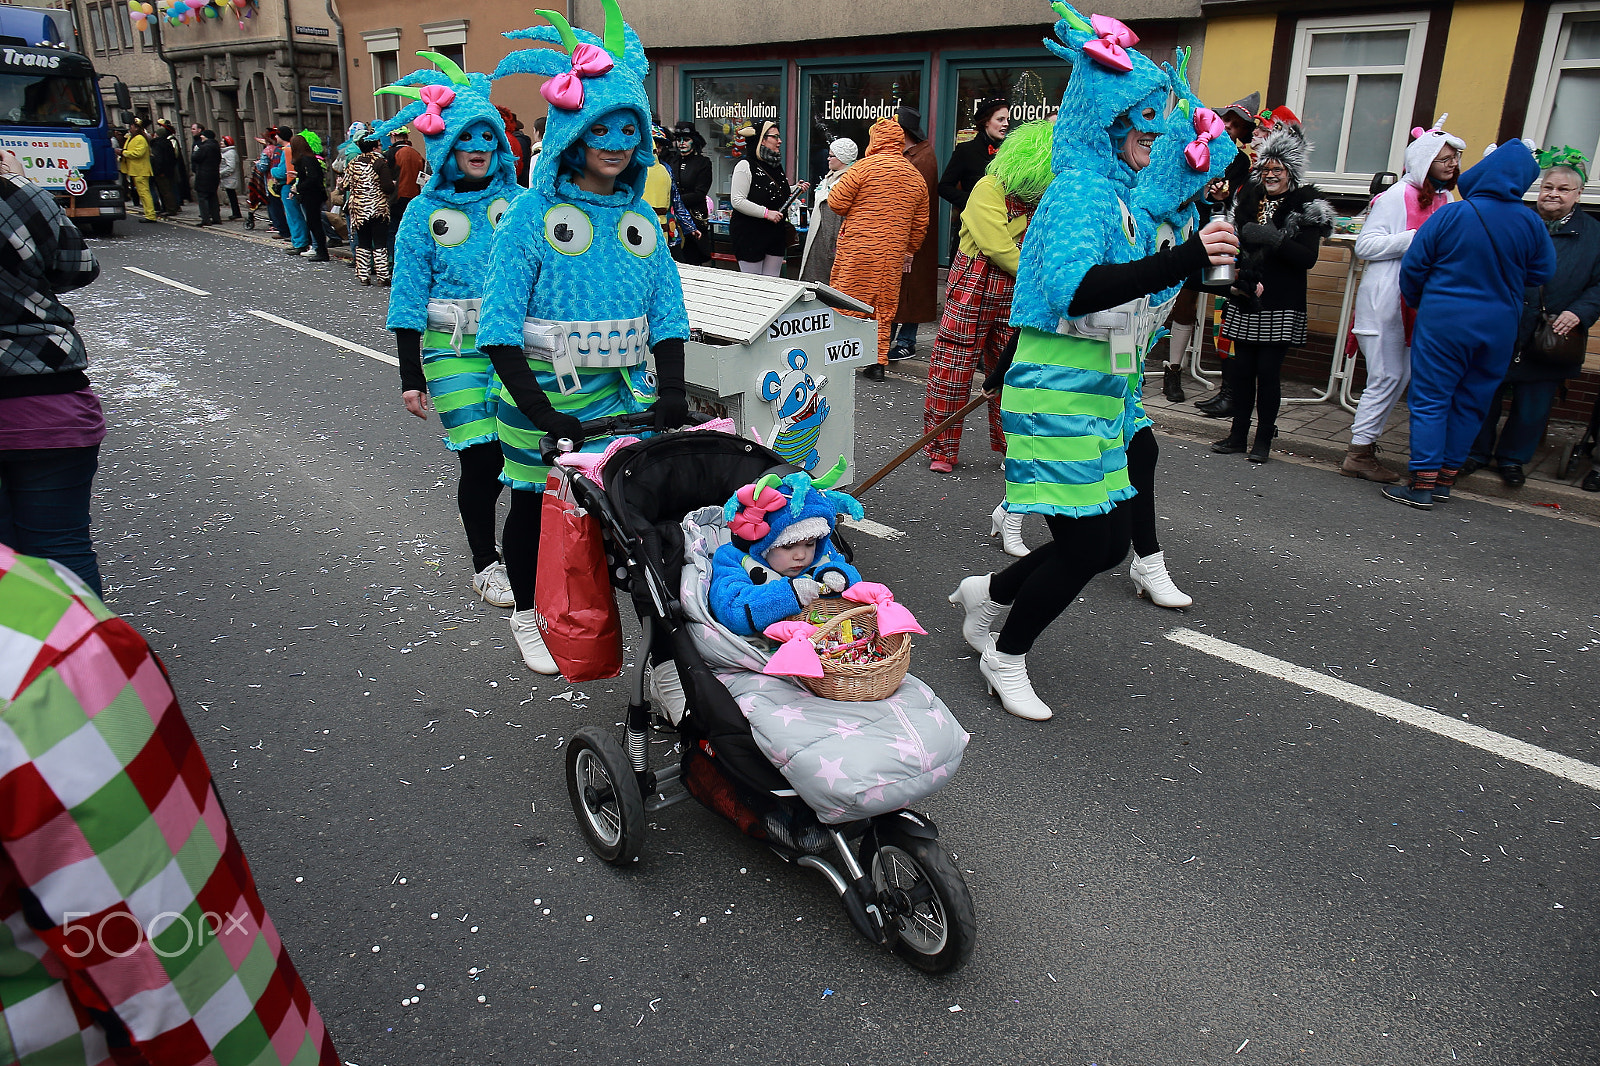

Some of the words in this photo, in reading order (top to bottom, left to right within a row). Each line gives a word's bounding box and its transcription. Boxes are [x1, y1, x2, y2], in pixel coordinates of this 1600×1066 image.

[3, 49, 60, 69] Trans
[695, 98, 777, 119] Elektroinstallation
[22, 156, 69, 170] JOAR
[70, 183, 82, 191] 20
[770, 313, 831, 339] SORCHE
[827, 340, 860, 362] WÖE
